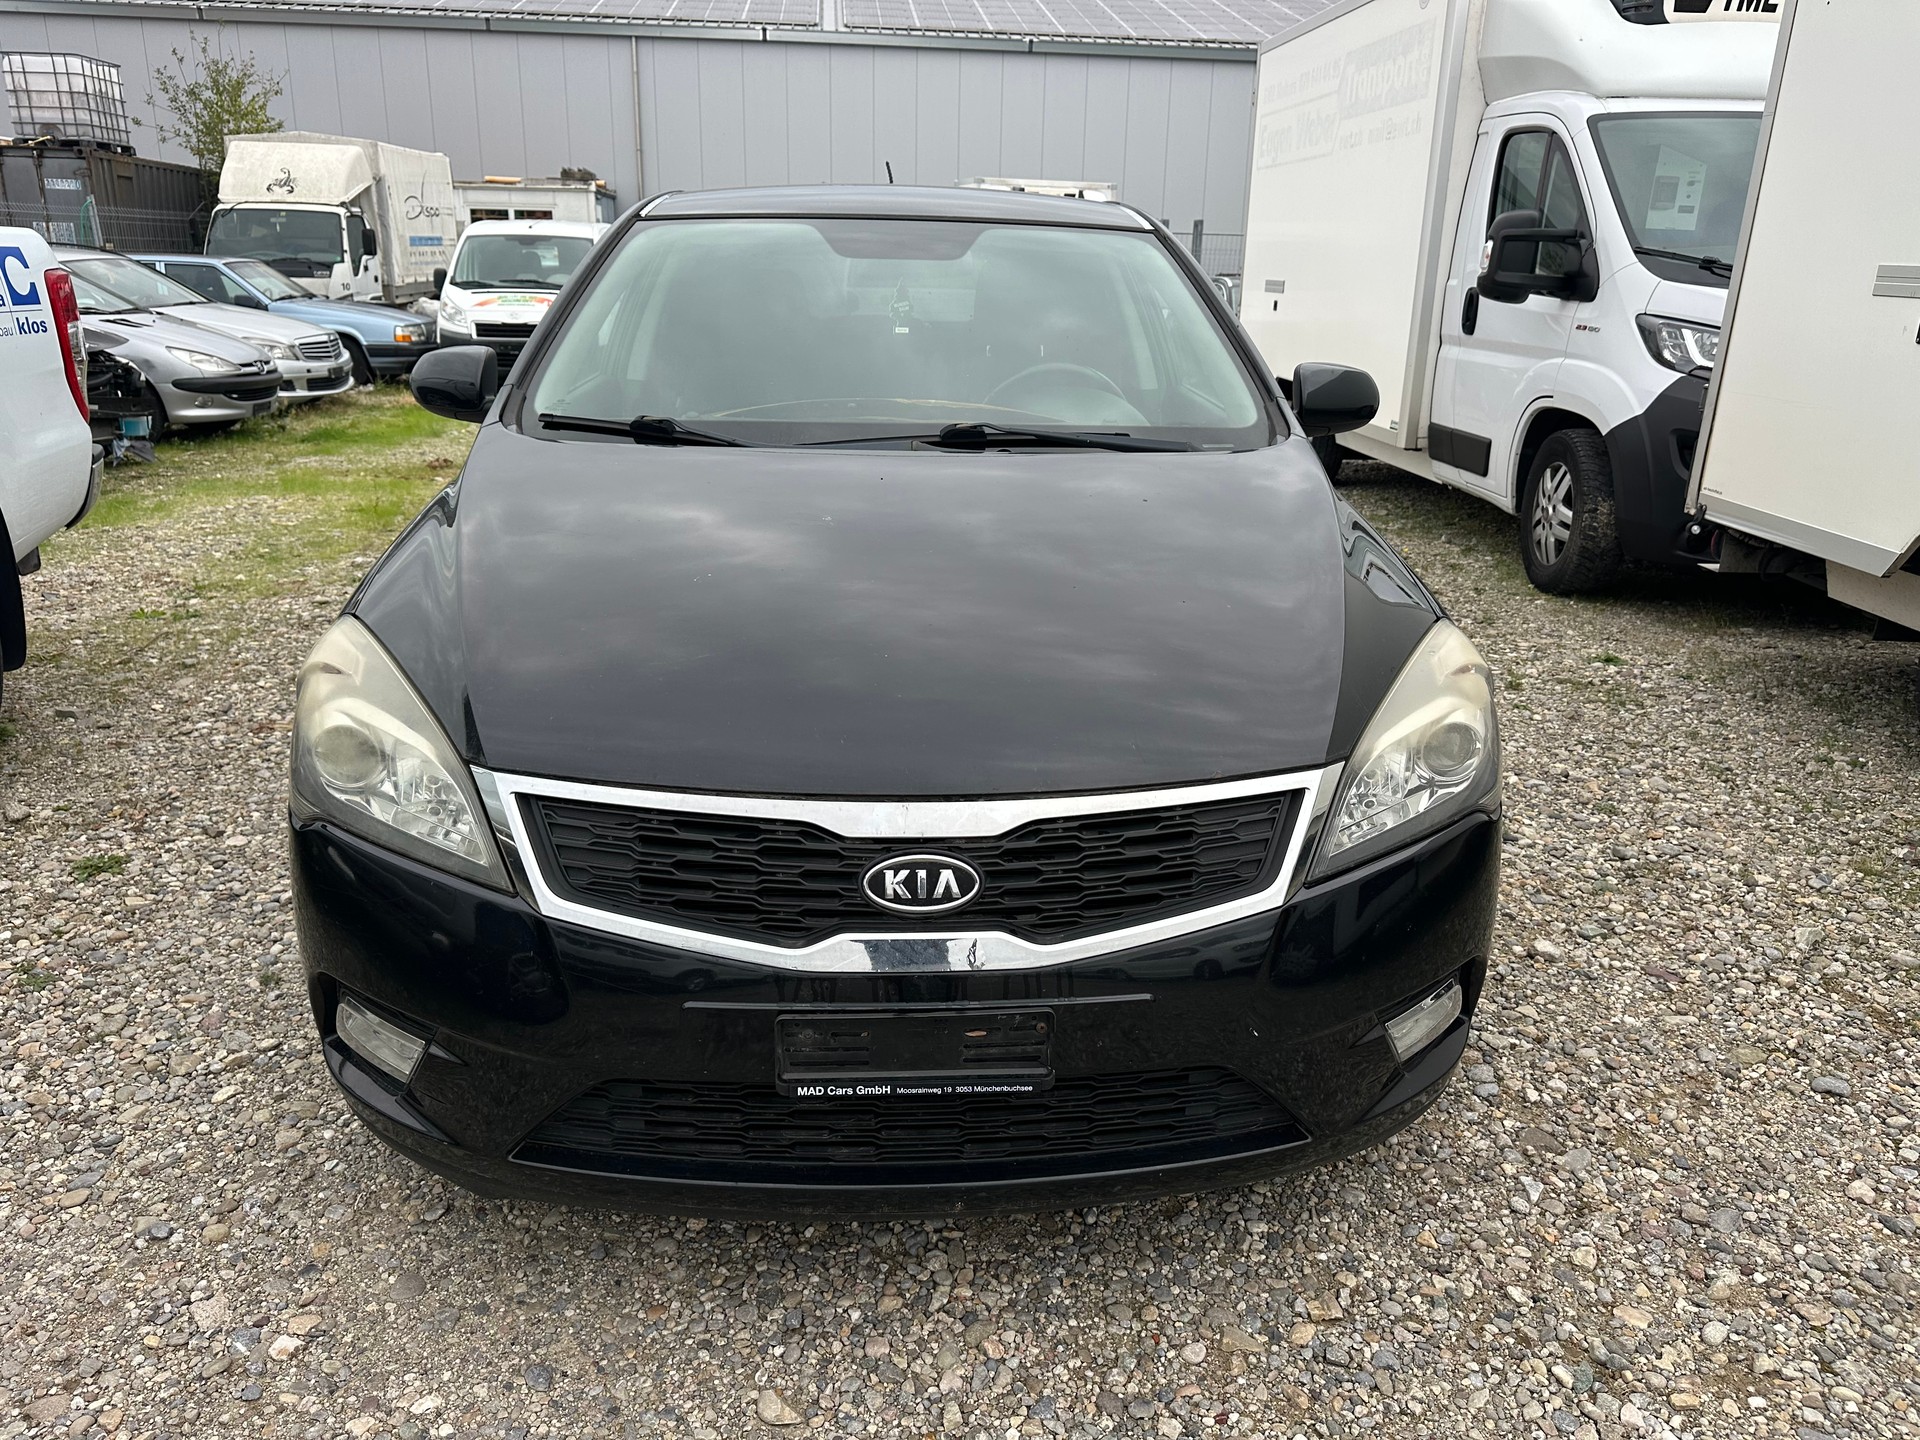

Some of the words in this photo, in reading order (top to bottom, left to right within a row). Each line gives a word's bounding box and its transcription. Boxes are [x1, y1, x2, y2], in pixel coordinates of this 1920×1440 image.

[1345, 44, 1420, 106] Transport
[1297, 109, 1340, 150] Weber
[341, 282, 351, 291] 10
[16, 316, 48, 335] klos
[883, 869, 961, 898] KIA
[797, 1086, 825, 1096] MAD
[827, 1086, 854, 1095] Cars
[856, 1085, 891, 1095] GmbH
[896, 1087, 942, 1095] Moosrainweg
[973, 1085, 1034, 1093] Münchenbuchsee
